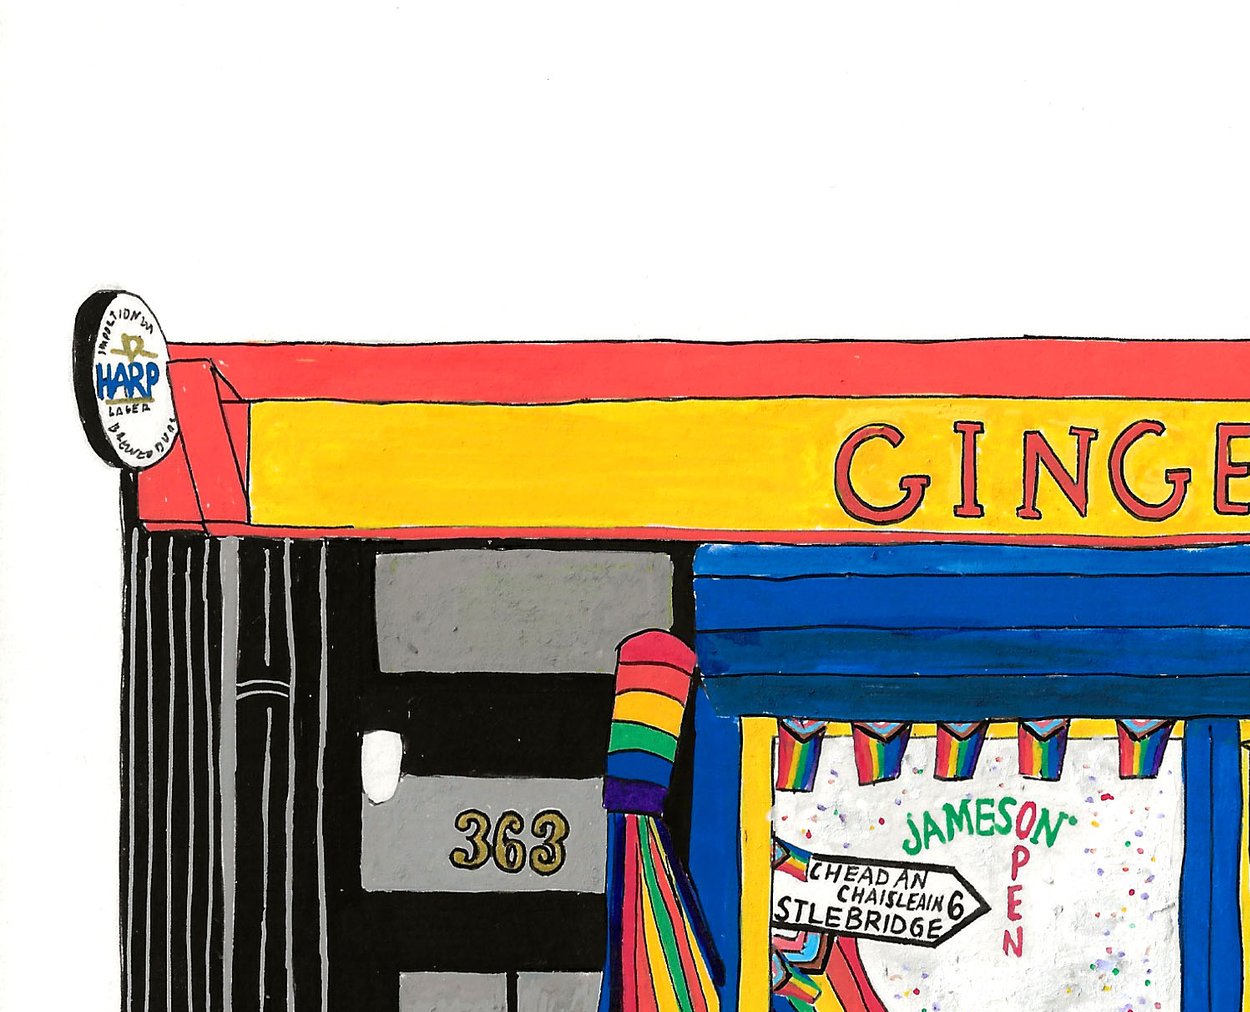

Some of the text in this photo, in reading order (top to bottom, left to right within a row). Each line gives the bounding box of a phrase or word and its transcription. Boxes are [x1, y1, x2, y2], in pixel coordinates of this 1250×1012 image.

[96, 361, 160, 400] HARP
[108, 403, 151, 417] LAGER
[448, 808, 571, 877] 363
[902, 796, 1069, 856] JAMESON
[809, 862, 928, 890] CHEAD AN
[1002, 801, 1037, 958] OPEN
[774, 895, 943, 939] STLEBRIDGE
[947, 890, 965, 921] 6
